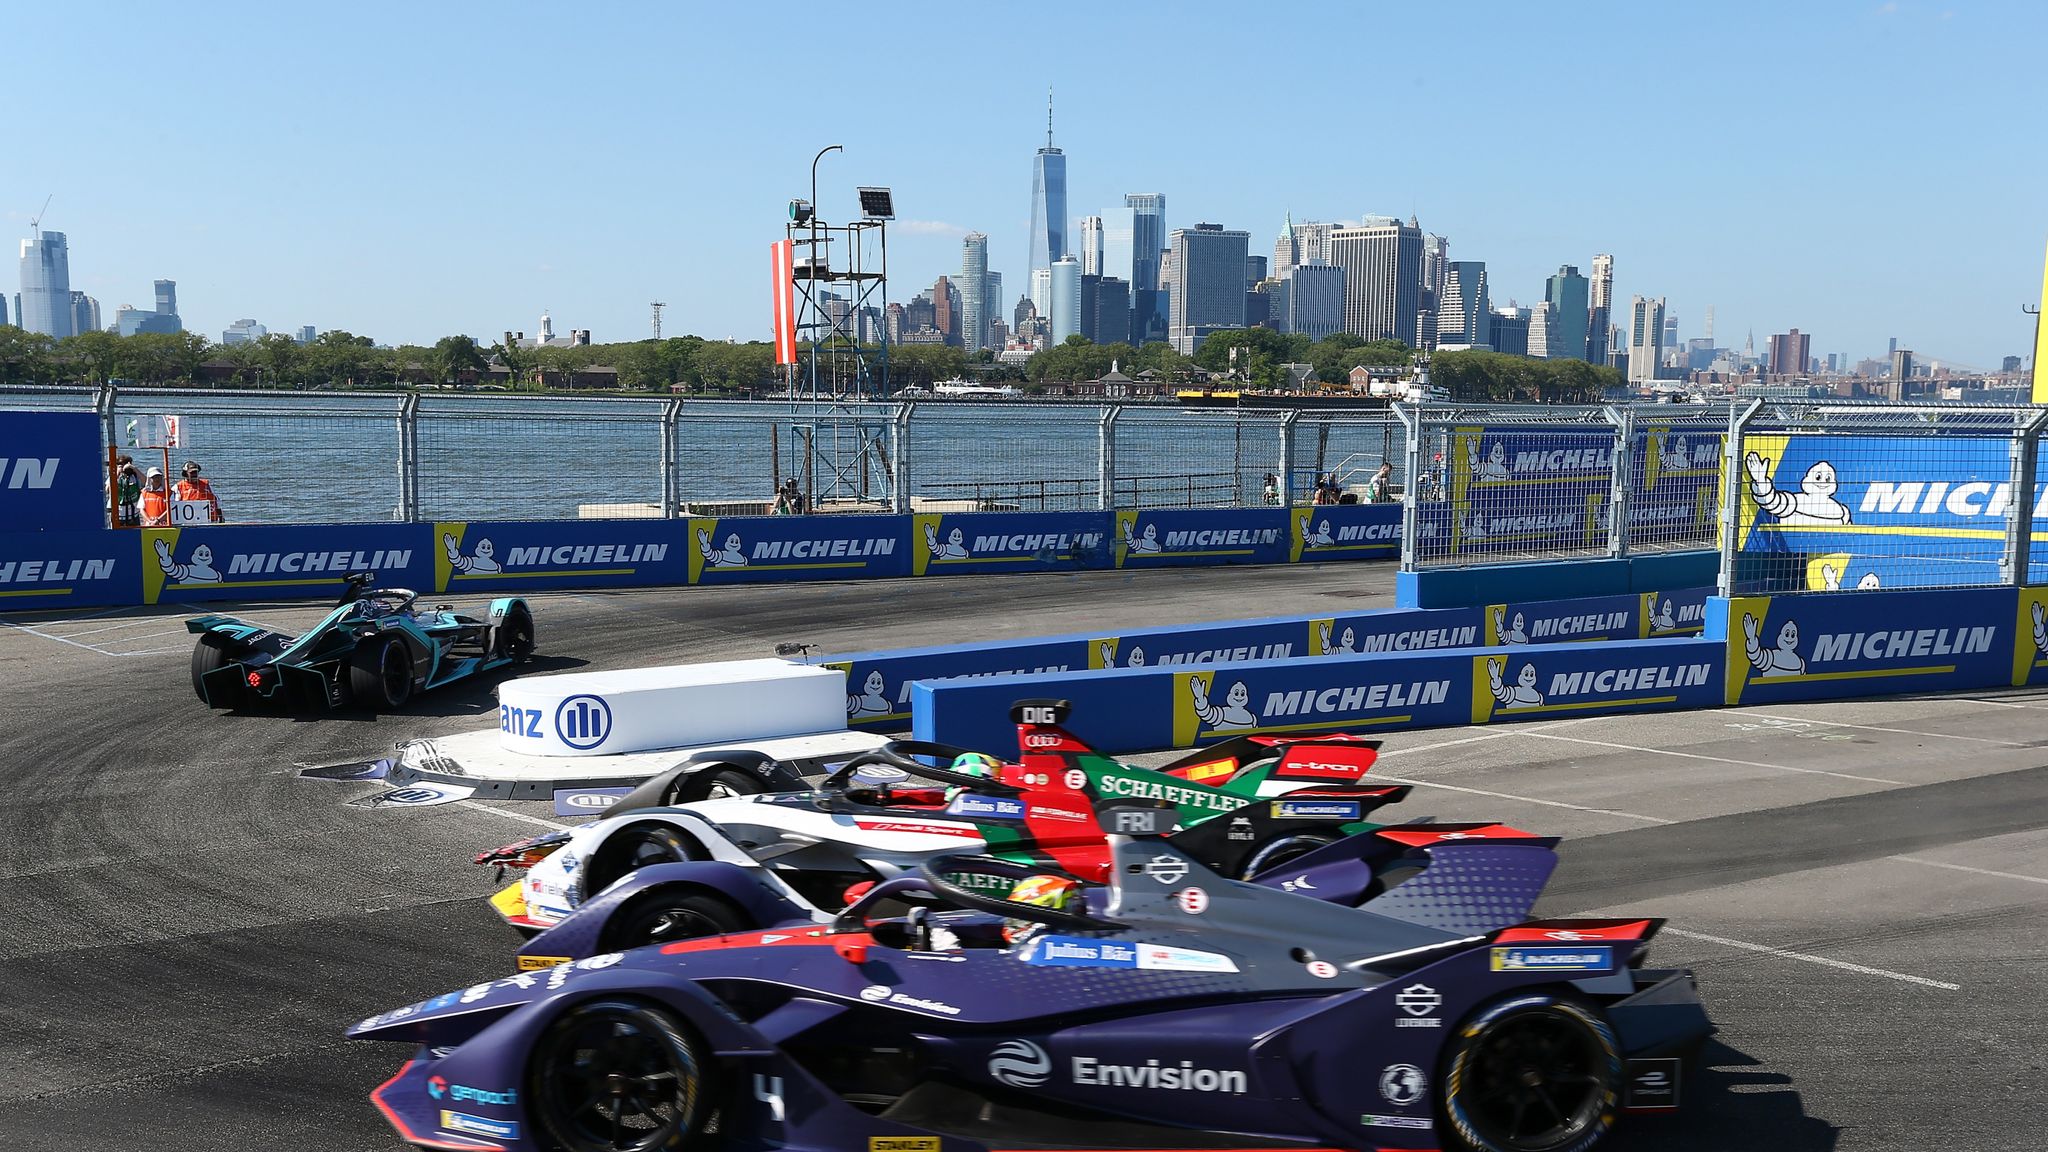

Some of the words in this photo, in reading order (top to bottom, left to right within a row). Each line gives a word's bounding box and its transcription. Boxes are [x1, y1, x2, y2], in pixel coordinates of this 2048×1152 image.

[171, 504, 211, 520] 10.1
[751, 538, 896, 559] MICHELIN
[973, 533, 1101, 552] MICHELIN
[1165, 529, 1278, 546] MICHELIN
[228, 549, 412, 575] MICHELIN
[506, 543, 668, 566] MICHELIN
[1530, 611, 1629, 638] MICHELIN
[1362, 626, 1477, 653] MICHELIN
[1811, 626, 1996, 663] MICHELIN
[1548, 663, 1711, 696] MICHELIN
[1263, 680, 1450, 717] MICHELIN
[1023, 707, 1055, 724] DIG
[1101, 775, 1250, 811] SCHAEFFLER
[1116, 812, 1155, 832] FRI
[1071, 1056, 1248, 1093] Envision
[754, 1074, 785, 1122] 4
